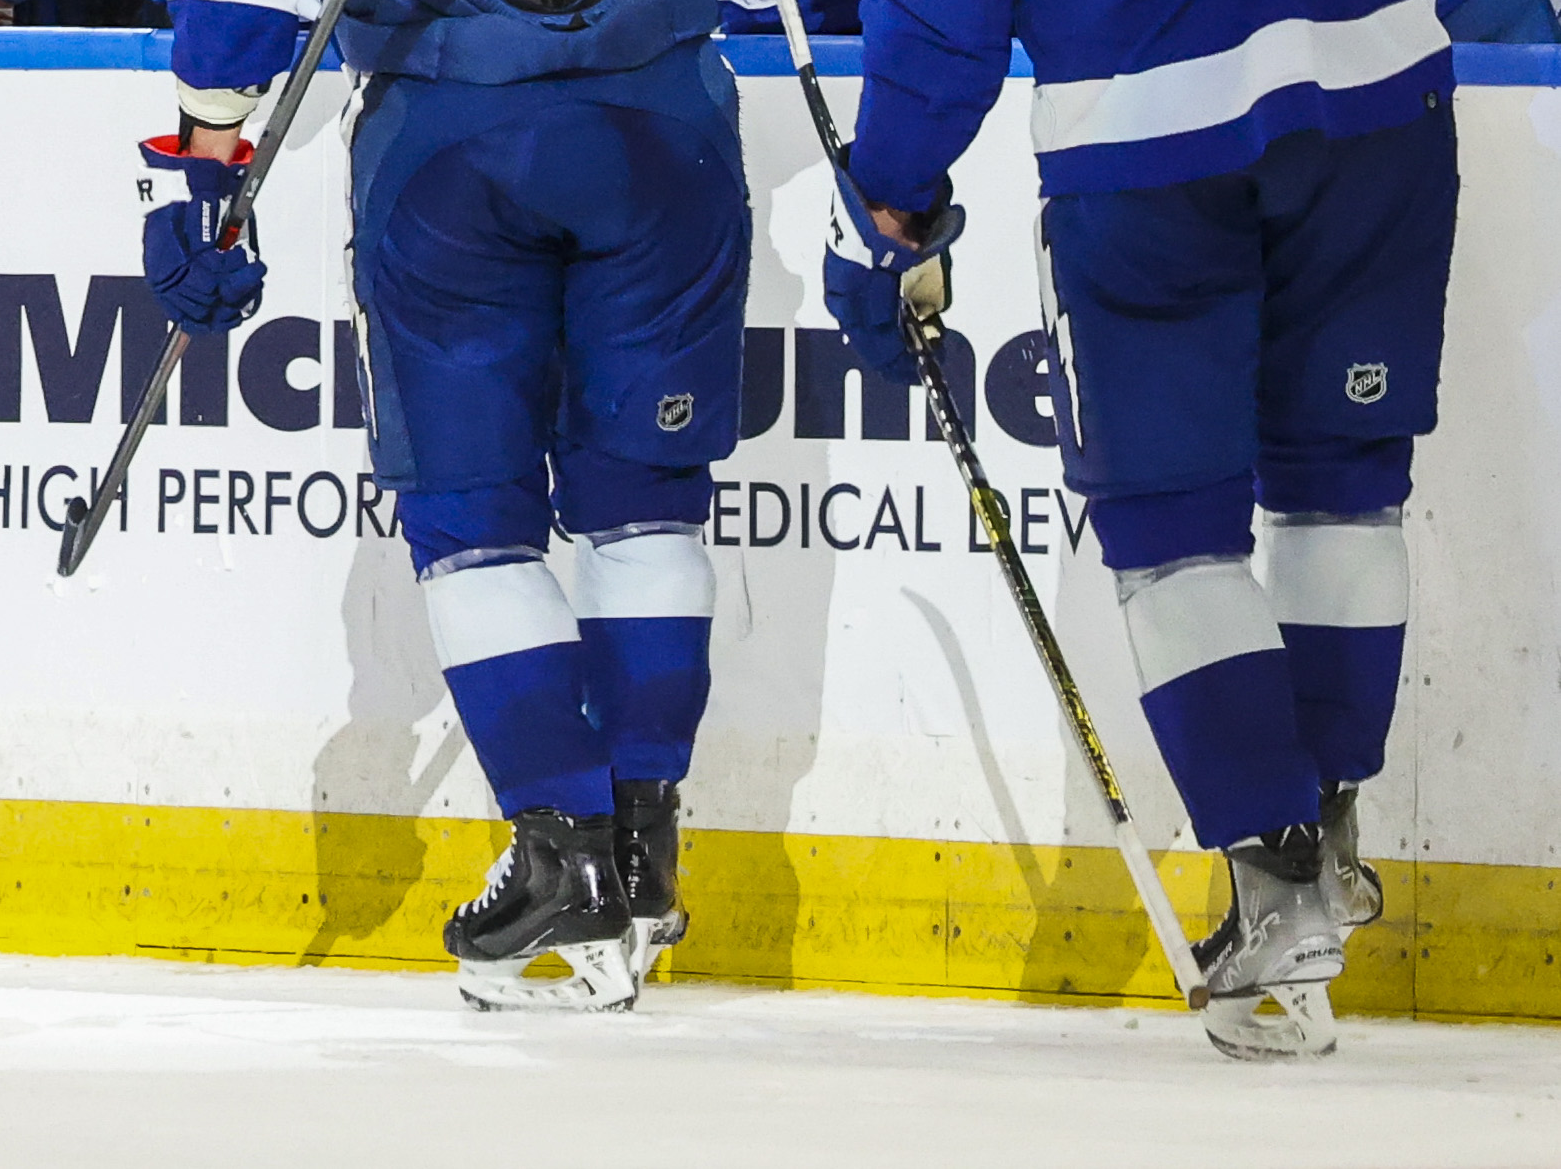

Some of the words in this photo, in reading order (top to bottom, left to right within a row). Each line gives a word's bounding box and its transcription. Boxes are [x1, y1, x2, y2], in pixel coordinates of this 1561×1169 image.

[157, 467, 403, 539] PERFOR
[702, 479, 942, 553] EDICAL
[968, 486, 1090, 557] DEV
